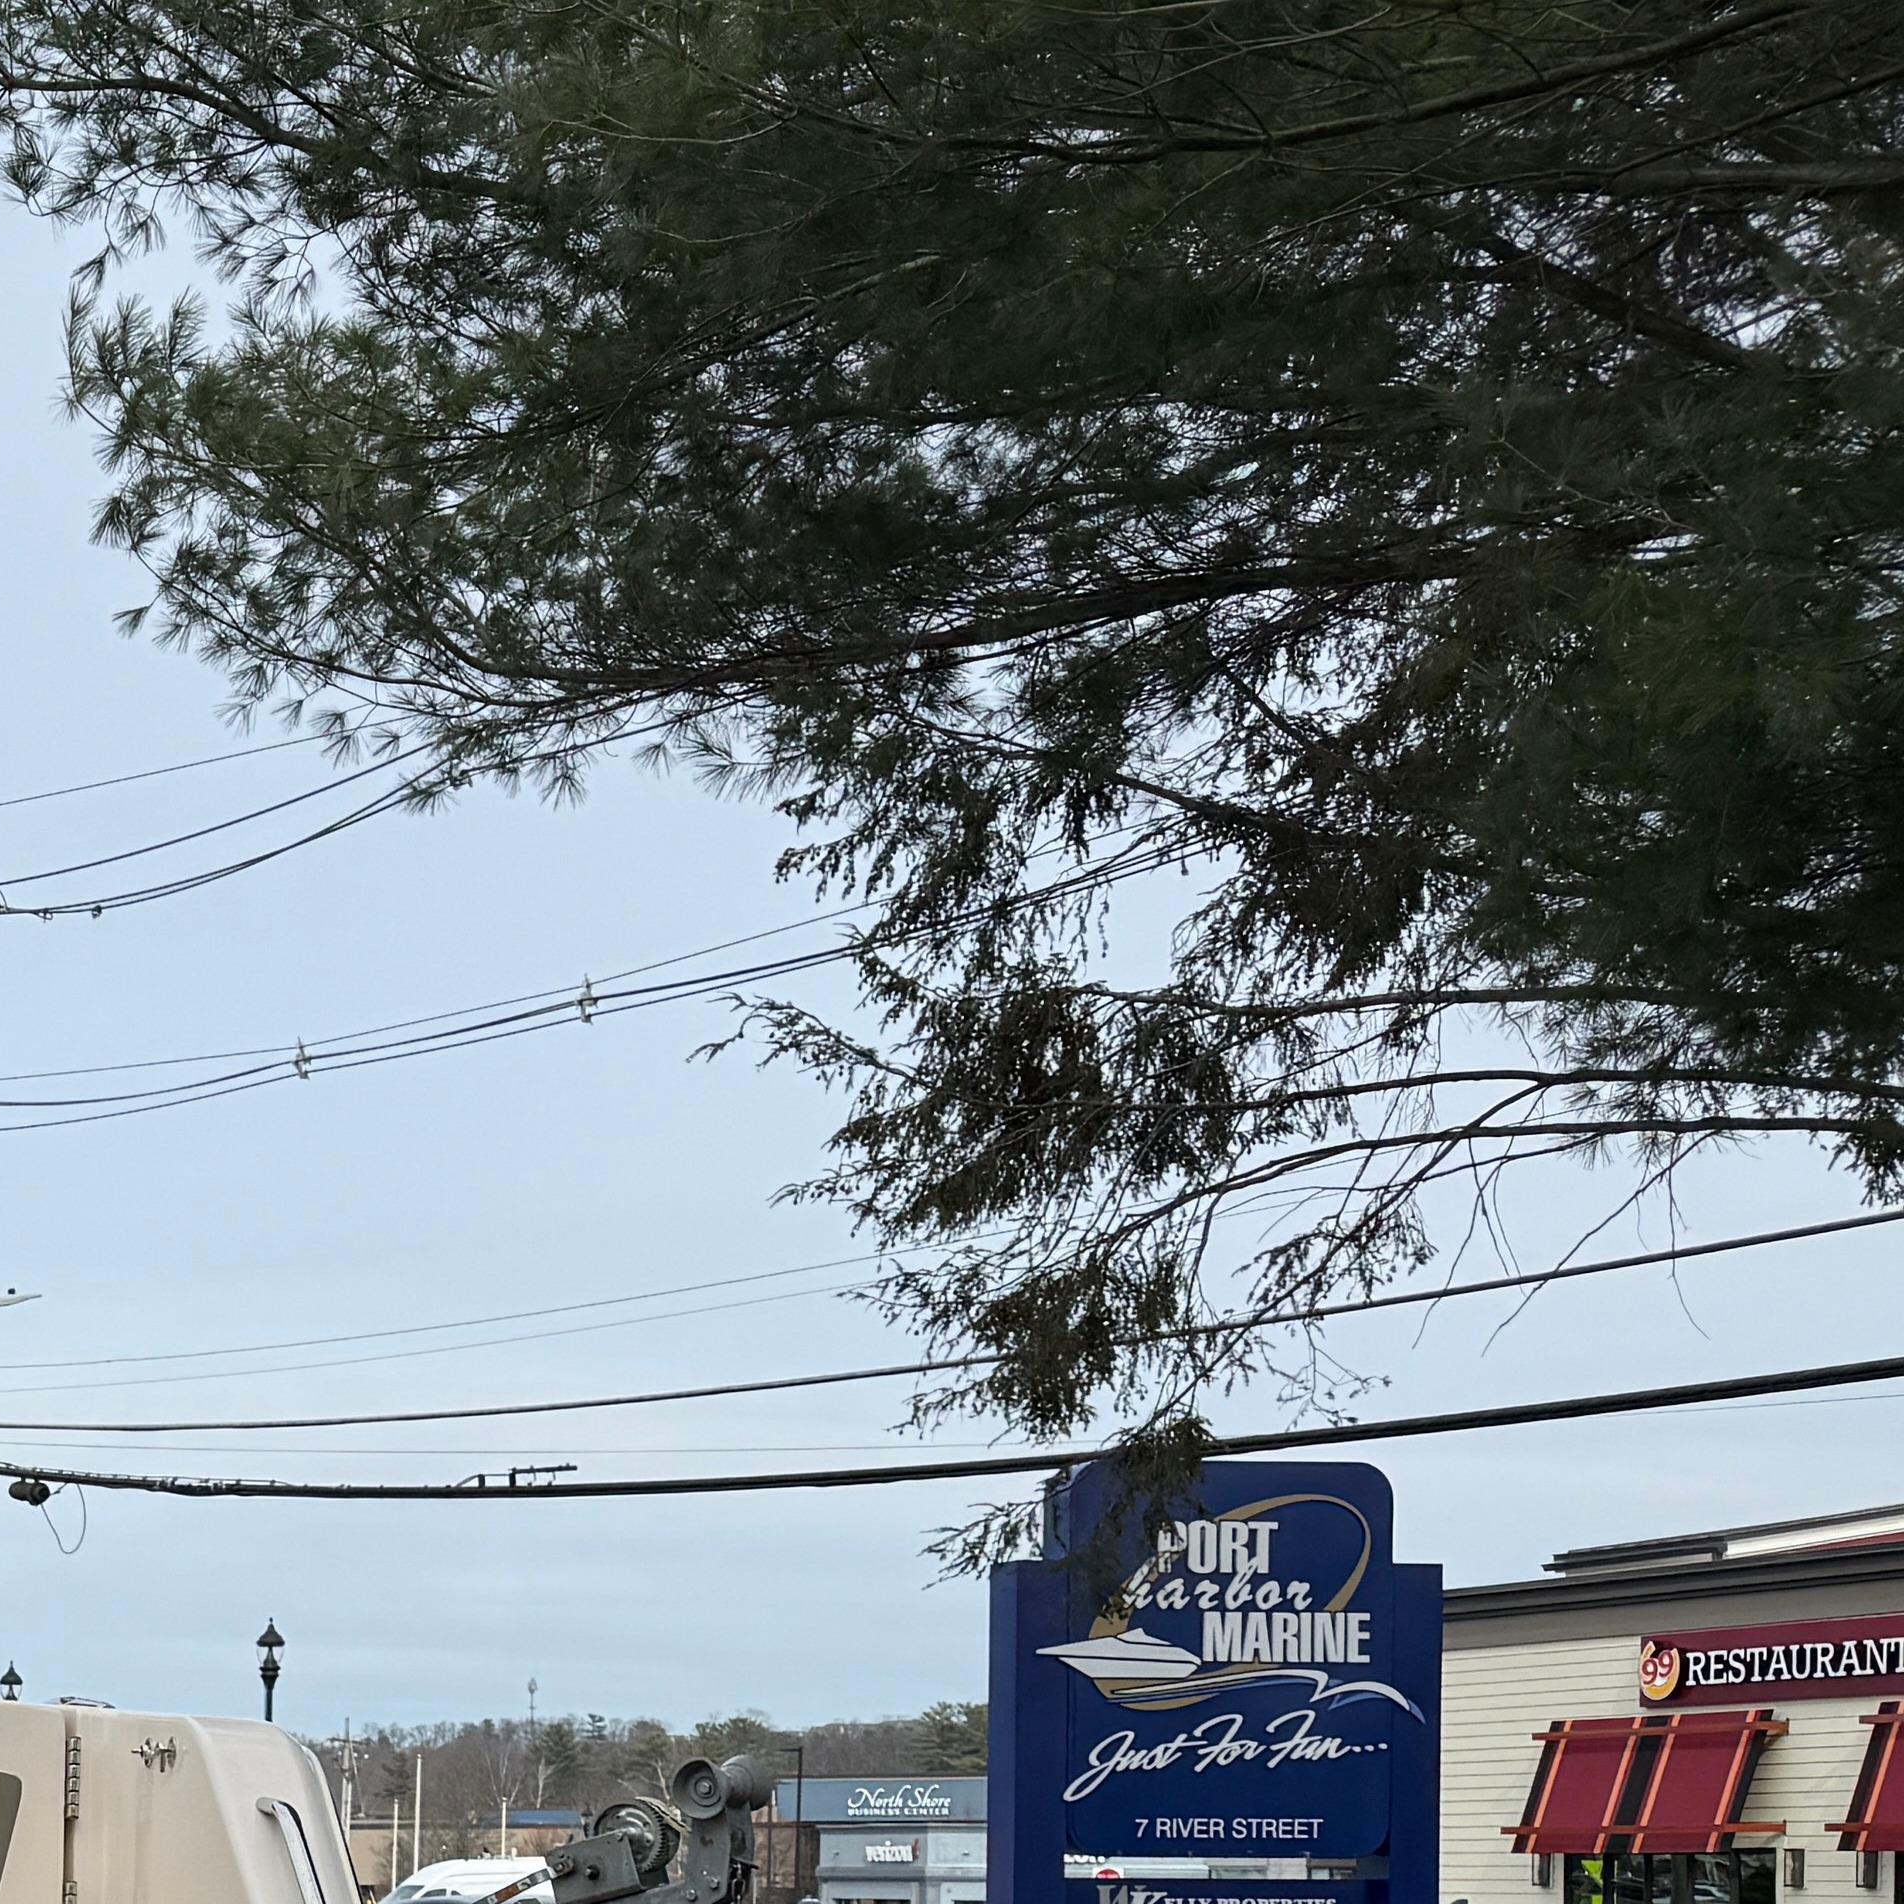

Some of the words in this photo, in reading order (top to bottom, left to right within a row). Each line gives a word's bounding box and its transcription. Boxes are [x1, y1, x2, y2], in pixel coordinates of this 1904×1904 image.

[1157, 1519, 1279, 1575] PORT
[1121, 1556, 1313, 1612] harbor
[1202, 1611, 1372, 1665] MARINE
[1685, 1637, 1904, 1687] RESTAURANT
[1062, 1730, 1202, 1801] Just
[1193, 1713, 1268, 1774] For
[1265, 1709, 1388, 1770] Fun...
[847, 1784, 912, 1808] North
[907, 1783, 952, 1808] Shore
[1135, 1818, 1149, 1839] 7
[1155, 1818, 1225, 1839] RIVER
[1231, 1818, 1324, 1839] STREET
